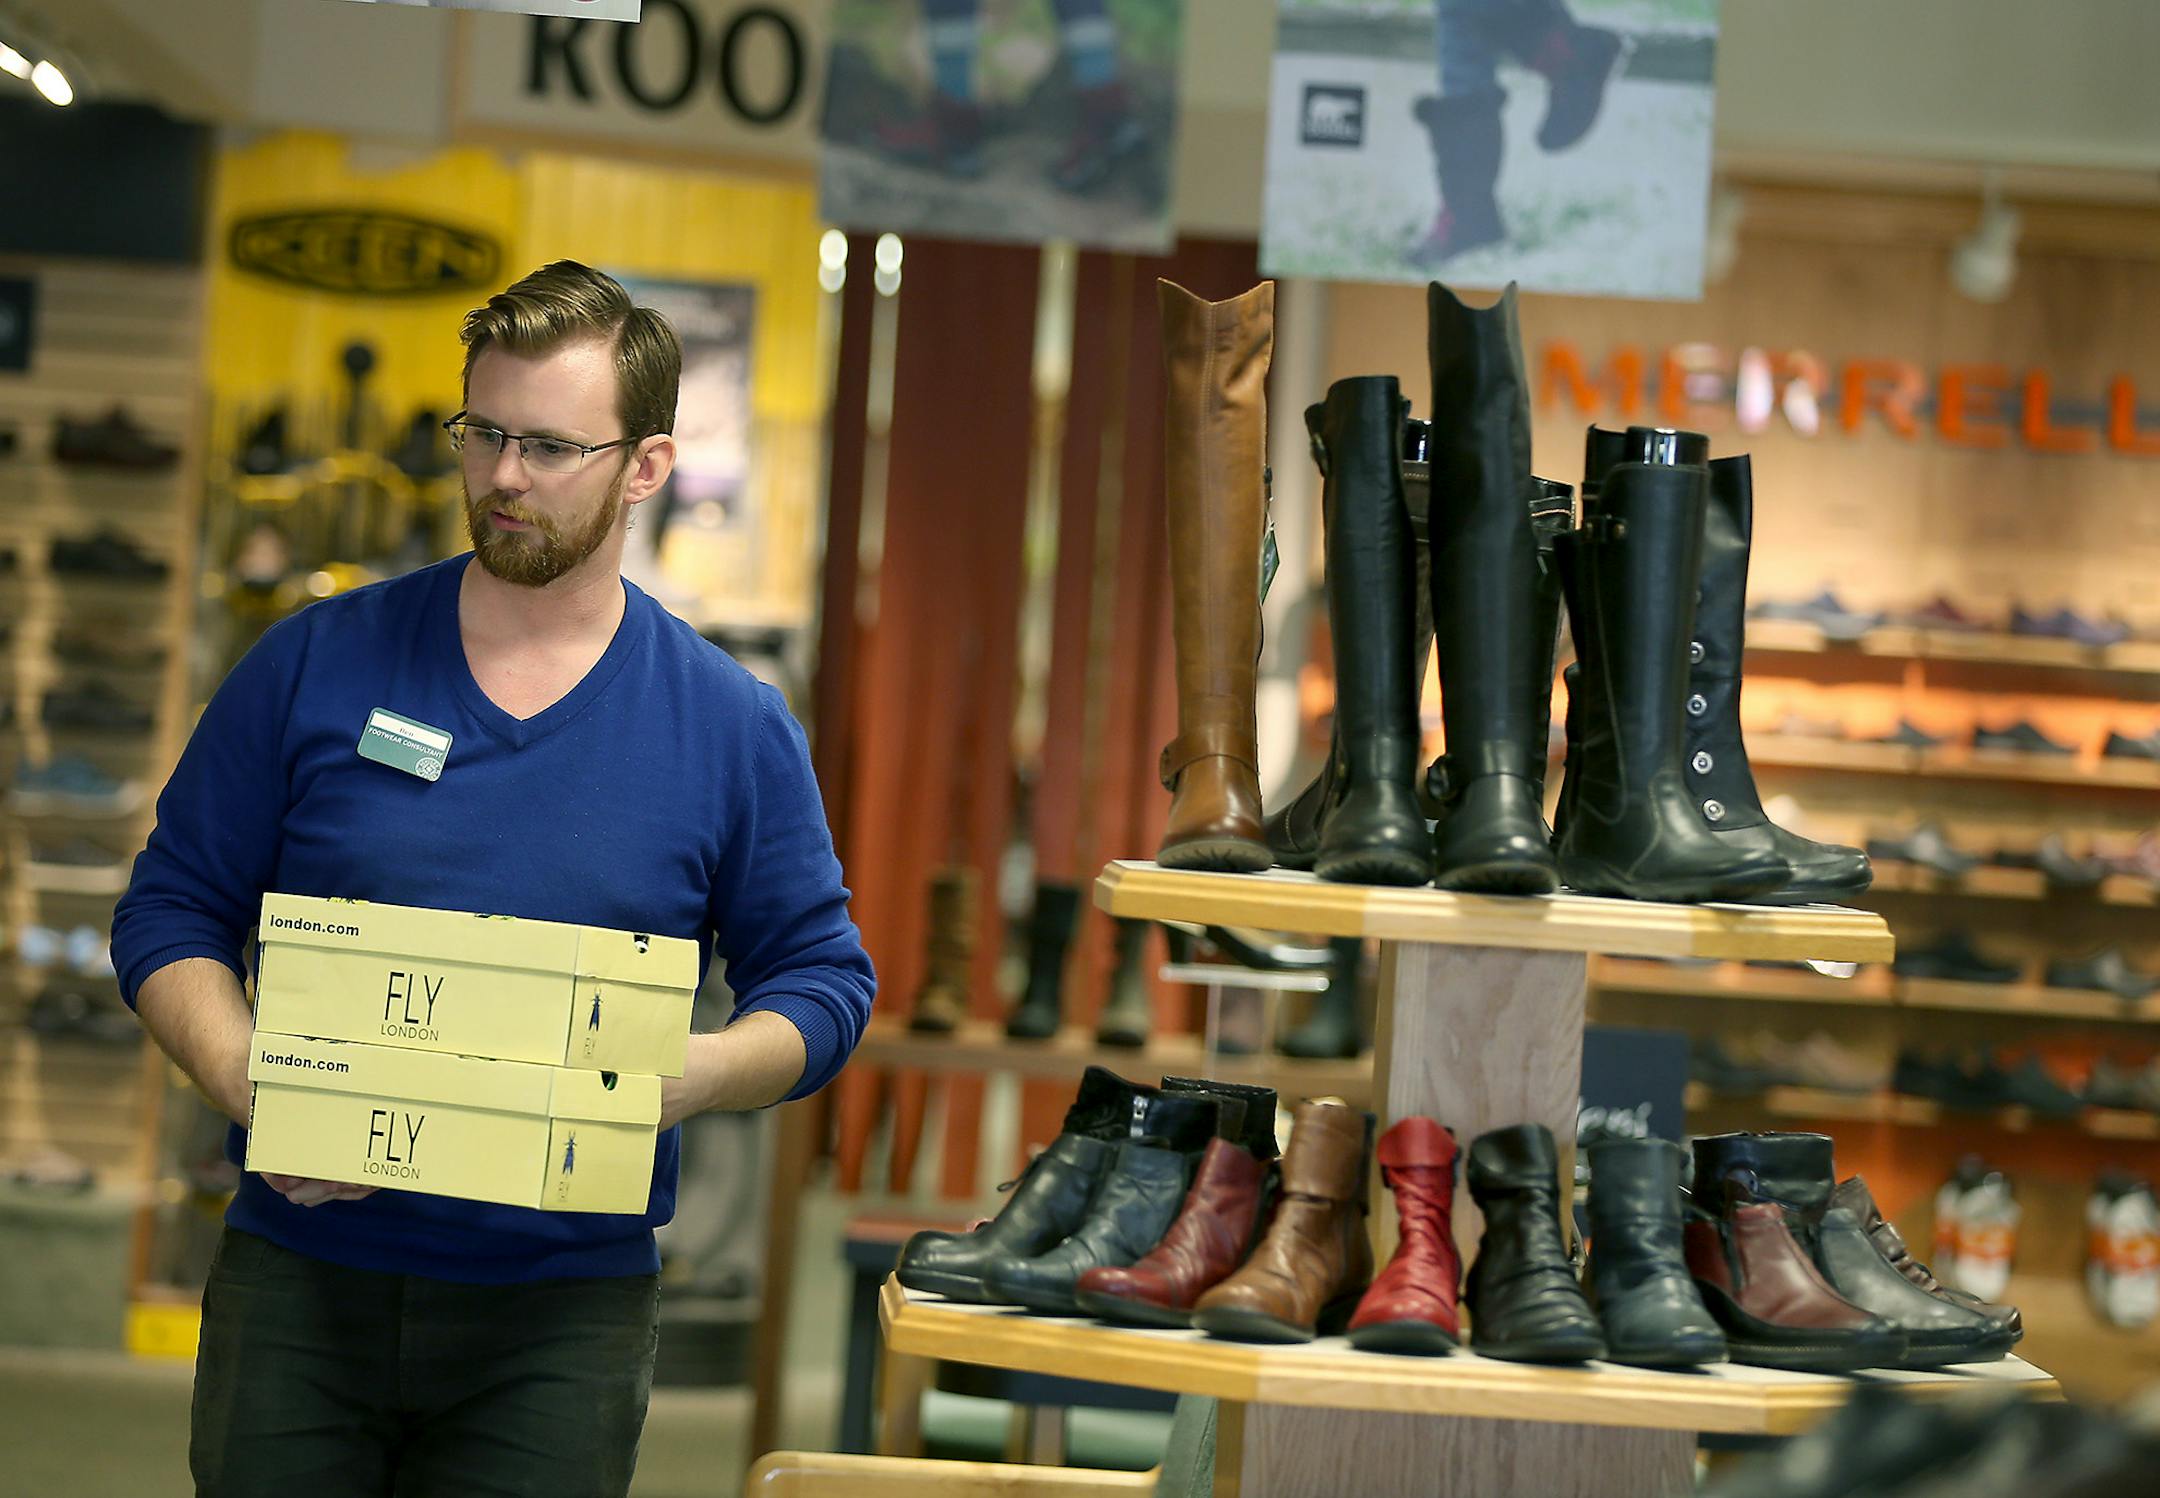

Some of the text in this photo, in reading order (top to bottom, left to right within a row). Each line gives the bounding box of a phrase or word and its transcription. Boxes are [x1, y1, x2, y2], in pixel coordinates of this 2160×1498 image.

[1539, 338, 2160, 457] MERRELL
[368, 726, 443, 759] FOOTWEAR CONSULTANT
[270, 914, 359, 936] london.com
[384, 971, 444, 1026] FLY
[380, 1023, 439, 1041] LONDON
[261, 1050, 349, 1073] london.com
[367, 1109, 425, 1164] FLY
[363, 1161, 420, 1179] LONDON
